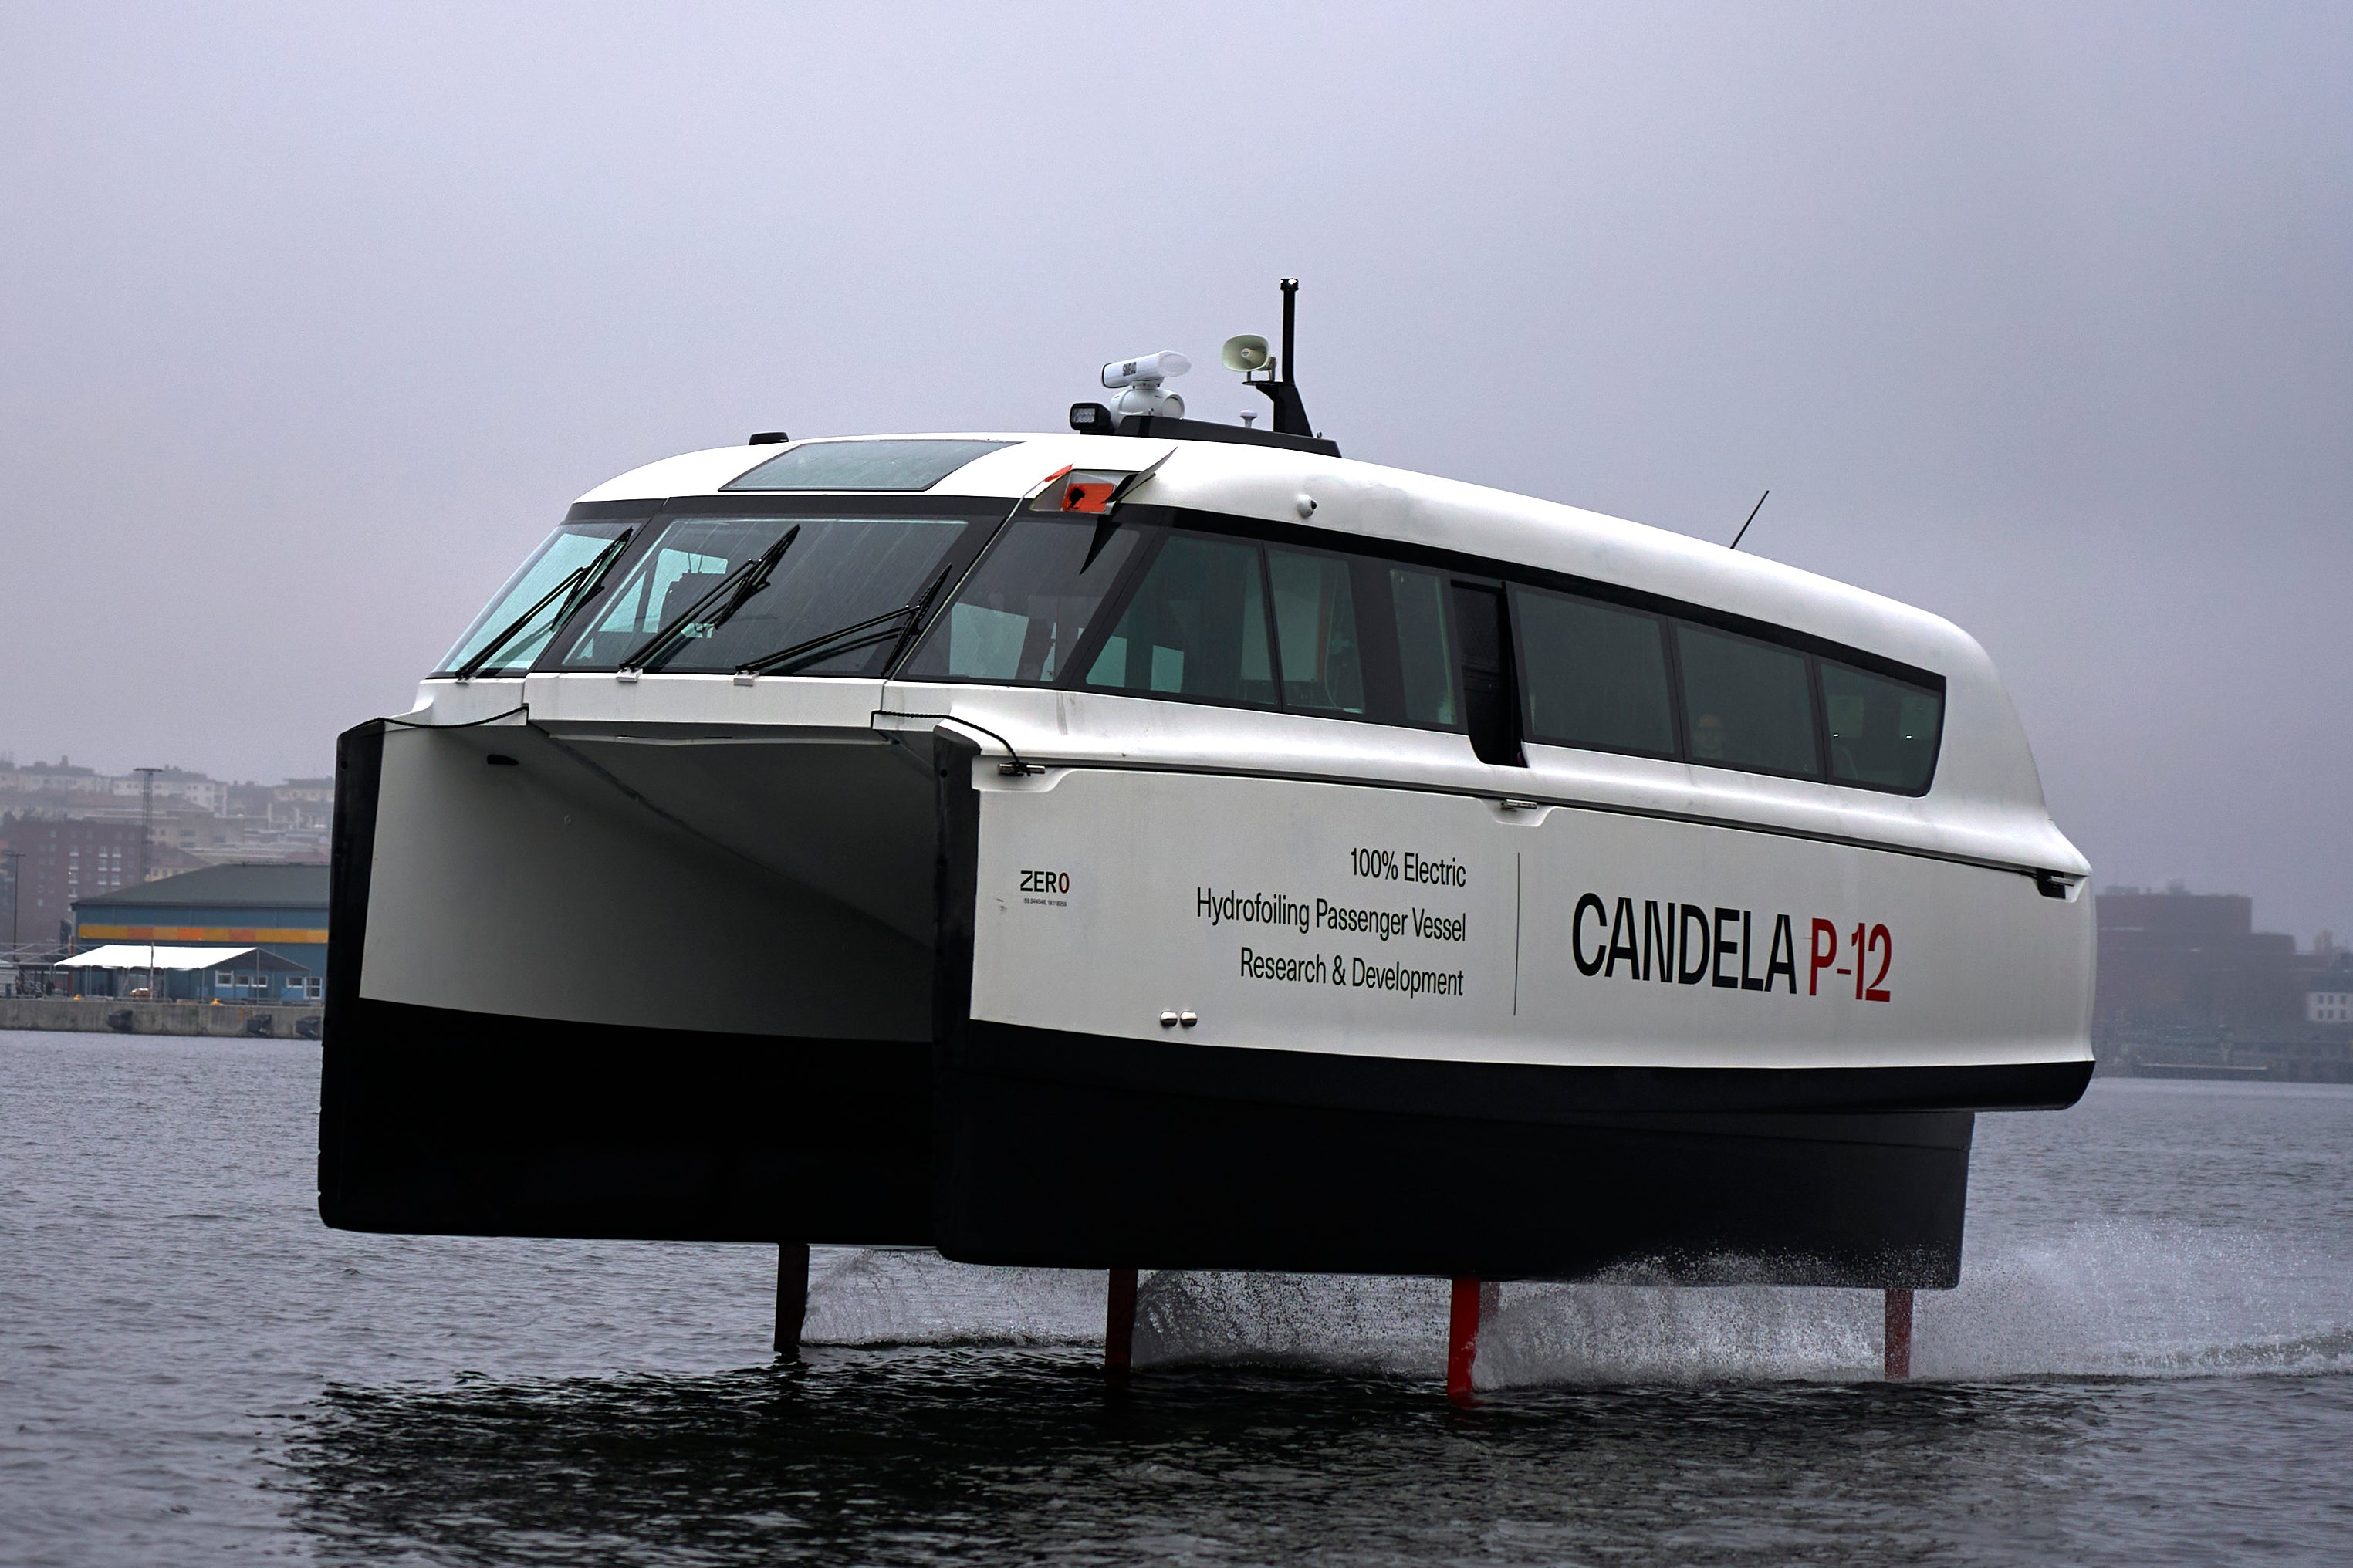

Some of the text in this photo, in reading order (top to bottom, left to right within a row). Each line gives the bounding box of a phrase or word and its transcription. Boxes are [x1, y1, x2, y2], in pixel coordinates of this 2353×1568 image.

[1019, 870, 1070, 894] ZERO
[1351, 847, 1466, 887] 100% Electric
[1197, 887, 1466, 942] Hydrofoiling Passenger Vessel
[1240, 946, 1464, 999] Research & Development
[1572, 892, 1892, 1002] CANDELA P-12
